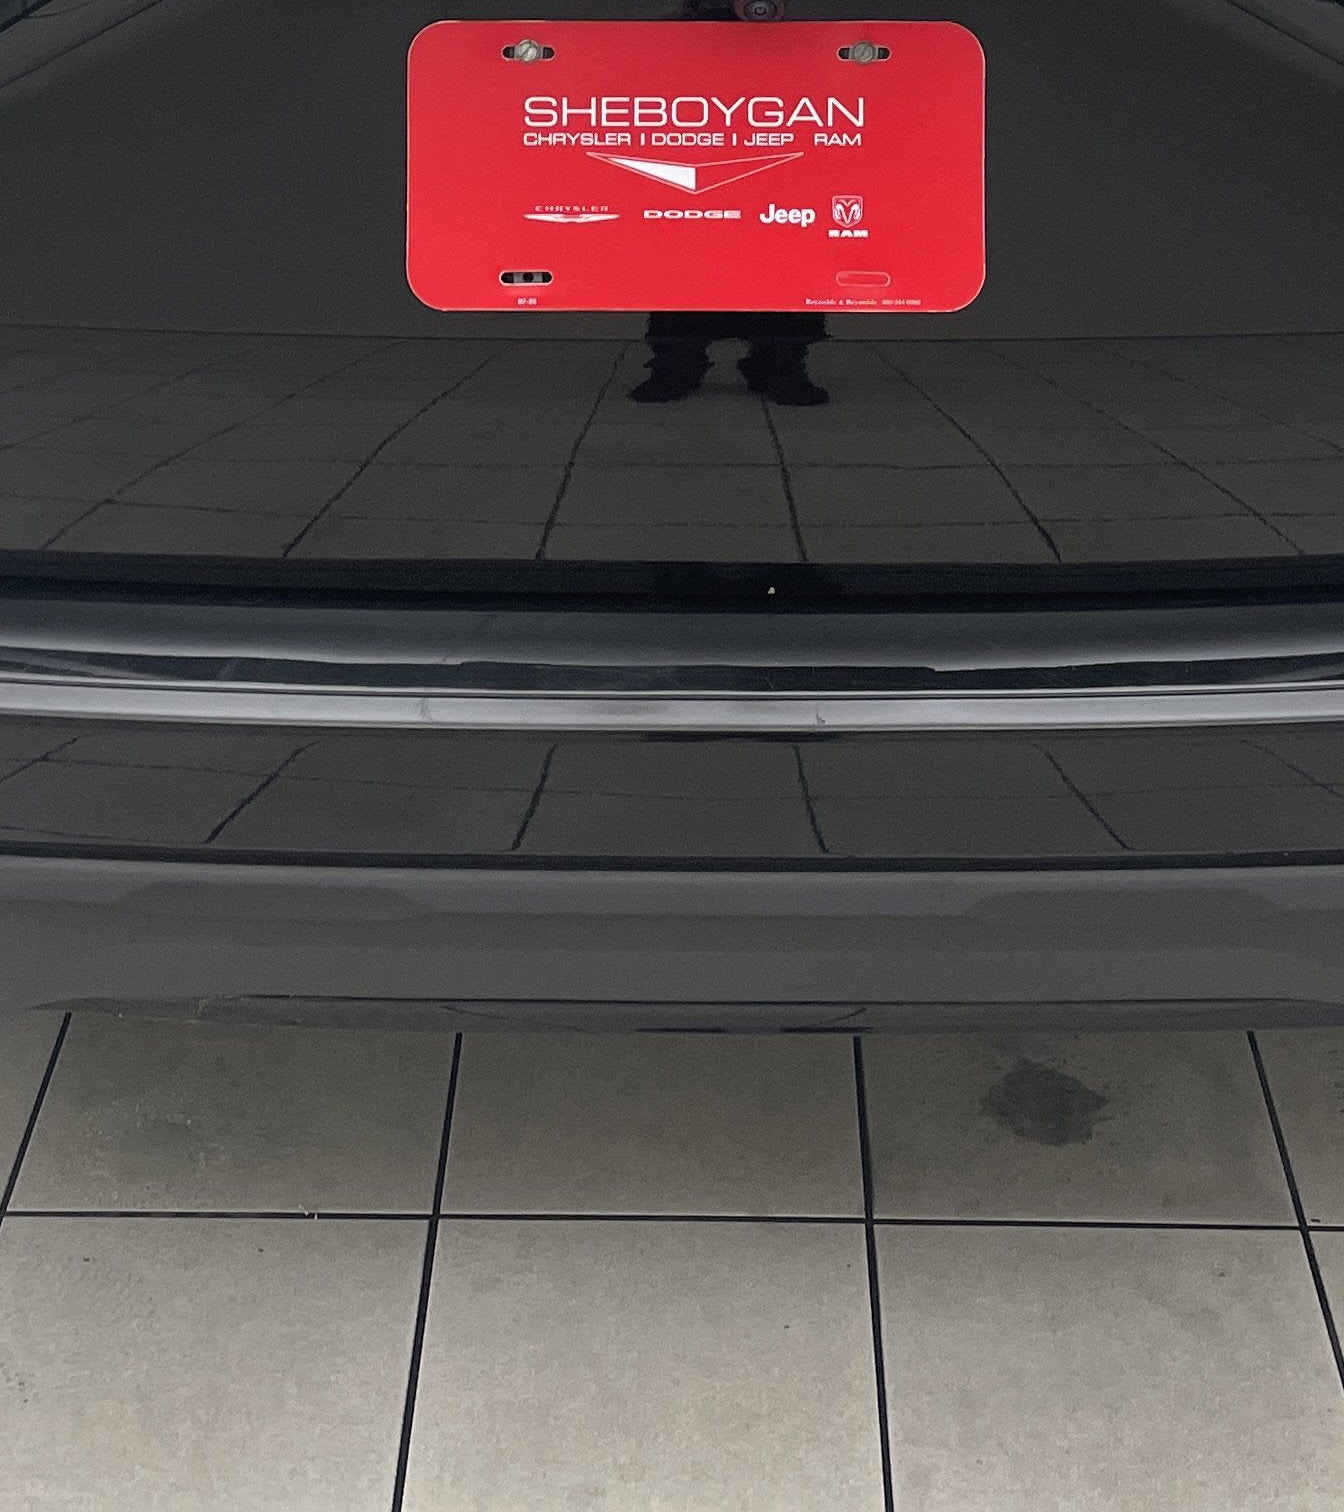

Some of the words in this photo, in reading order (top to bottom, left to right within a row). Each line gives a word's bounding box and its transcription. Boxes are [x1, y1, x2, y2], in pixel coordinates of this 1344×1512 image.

[523, 95, 865, 128] SHEBOYGAN
[522, 131, 632, 147] CHRYSLER
[651, 132, 725, 147] DODGE
[743, 132, 795, 147] JEEP
[813, 132, 862, 147] RAM
[534, 204, 609, 212] CHRYSLER
[643, 209, 742, 220] DODGE
[759, 203, 816, 227] Jeep
[828, 229, 869, 238] RAM
